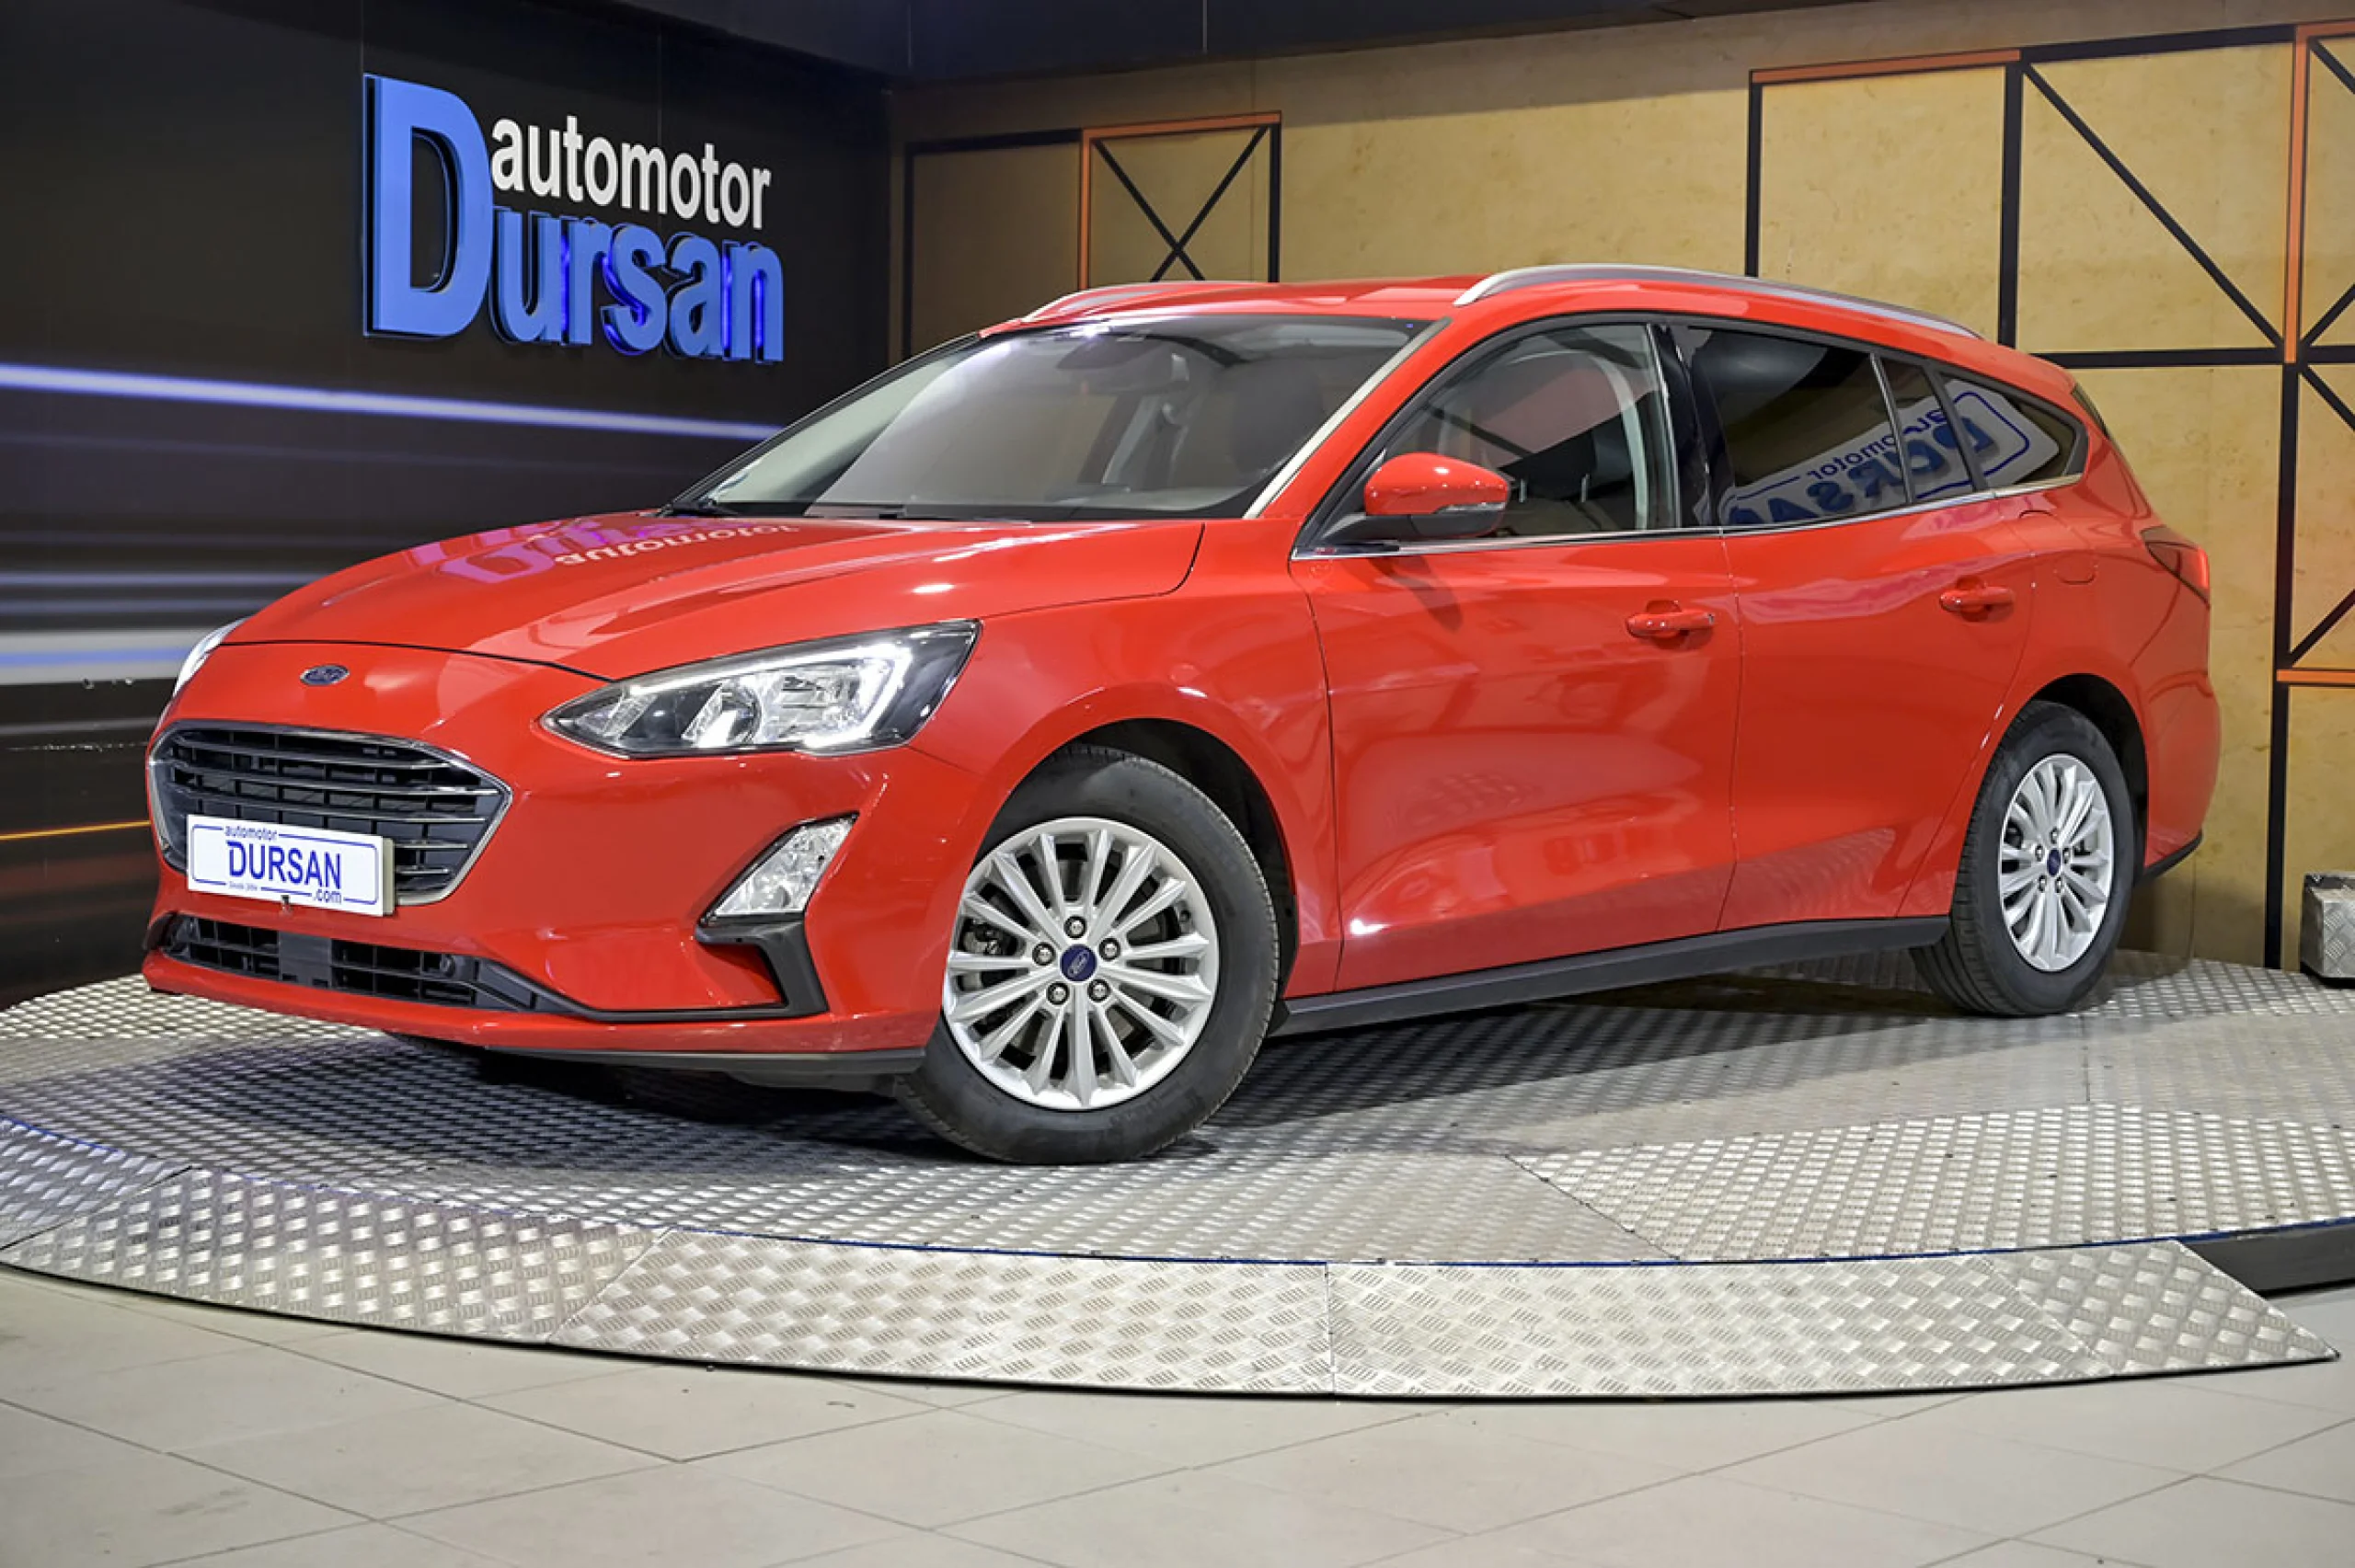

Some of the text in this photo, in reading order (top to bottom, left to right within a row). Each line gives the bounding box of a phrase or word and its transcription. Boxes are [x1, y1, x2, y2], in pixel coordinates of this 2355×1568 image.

[490, 116, 772, 230] automotor
[363, 73, 785, 365] Dursan
[224, 826, 278, 841] automotor
[227, 841, 342, 890] DURSAN
